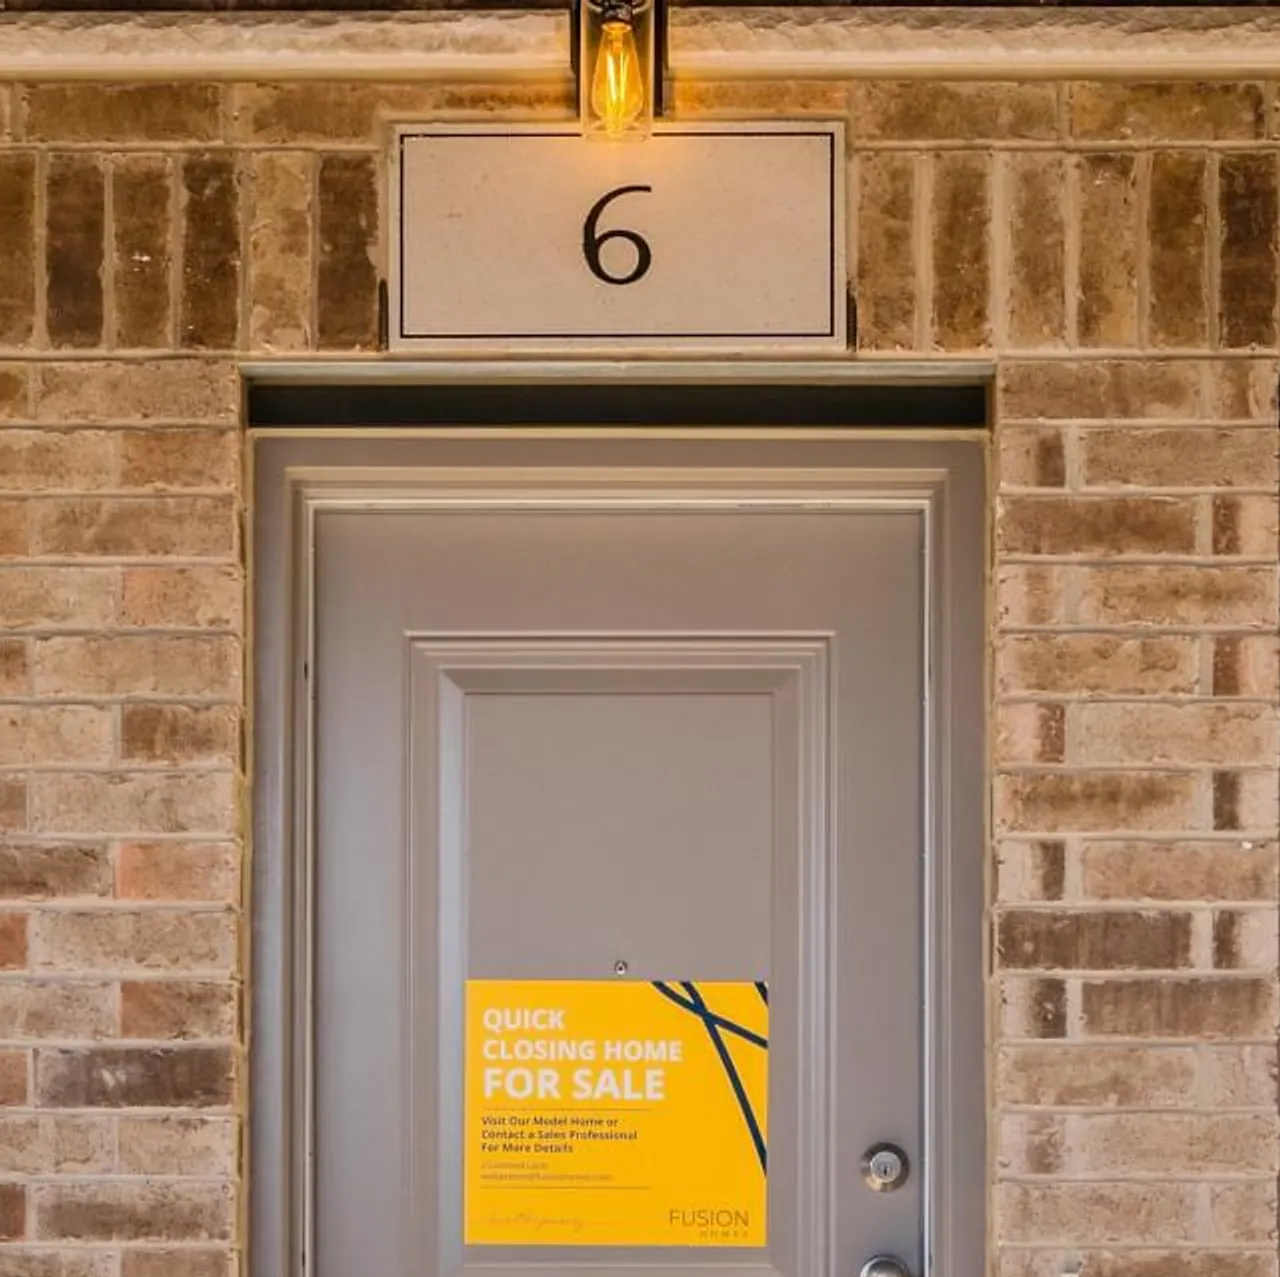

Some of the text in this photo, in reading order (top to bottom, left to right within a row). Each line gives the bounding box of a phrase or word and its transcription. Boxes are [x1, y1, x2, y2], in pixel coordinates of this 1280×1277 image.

[581, 184, 654, 286] 6
[482, 1007, 566, 1033] QUICK
[481, 1038, 683, 1062] CLOSING HOME
[483, 1068, 666, 1100] FOR SALE
[481, 1115, 619, 1127] Visit Our Model Home or
[481, 1129, 638, 1140] Contact a Sales Professional
[481, 1142, 574, 1154] For More Details
[669, 1208, 749, 1228] FUSION
